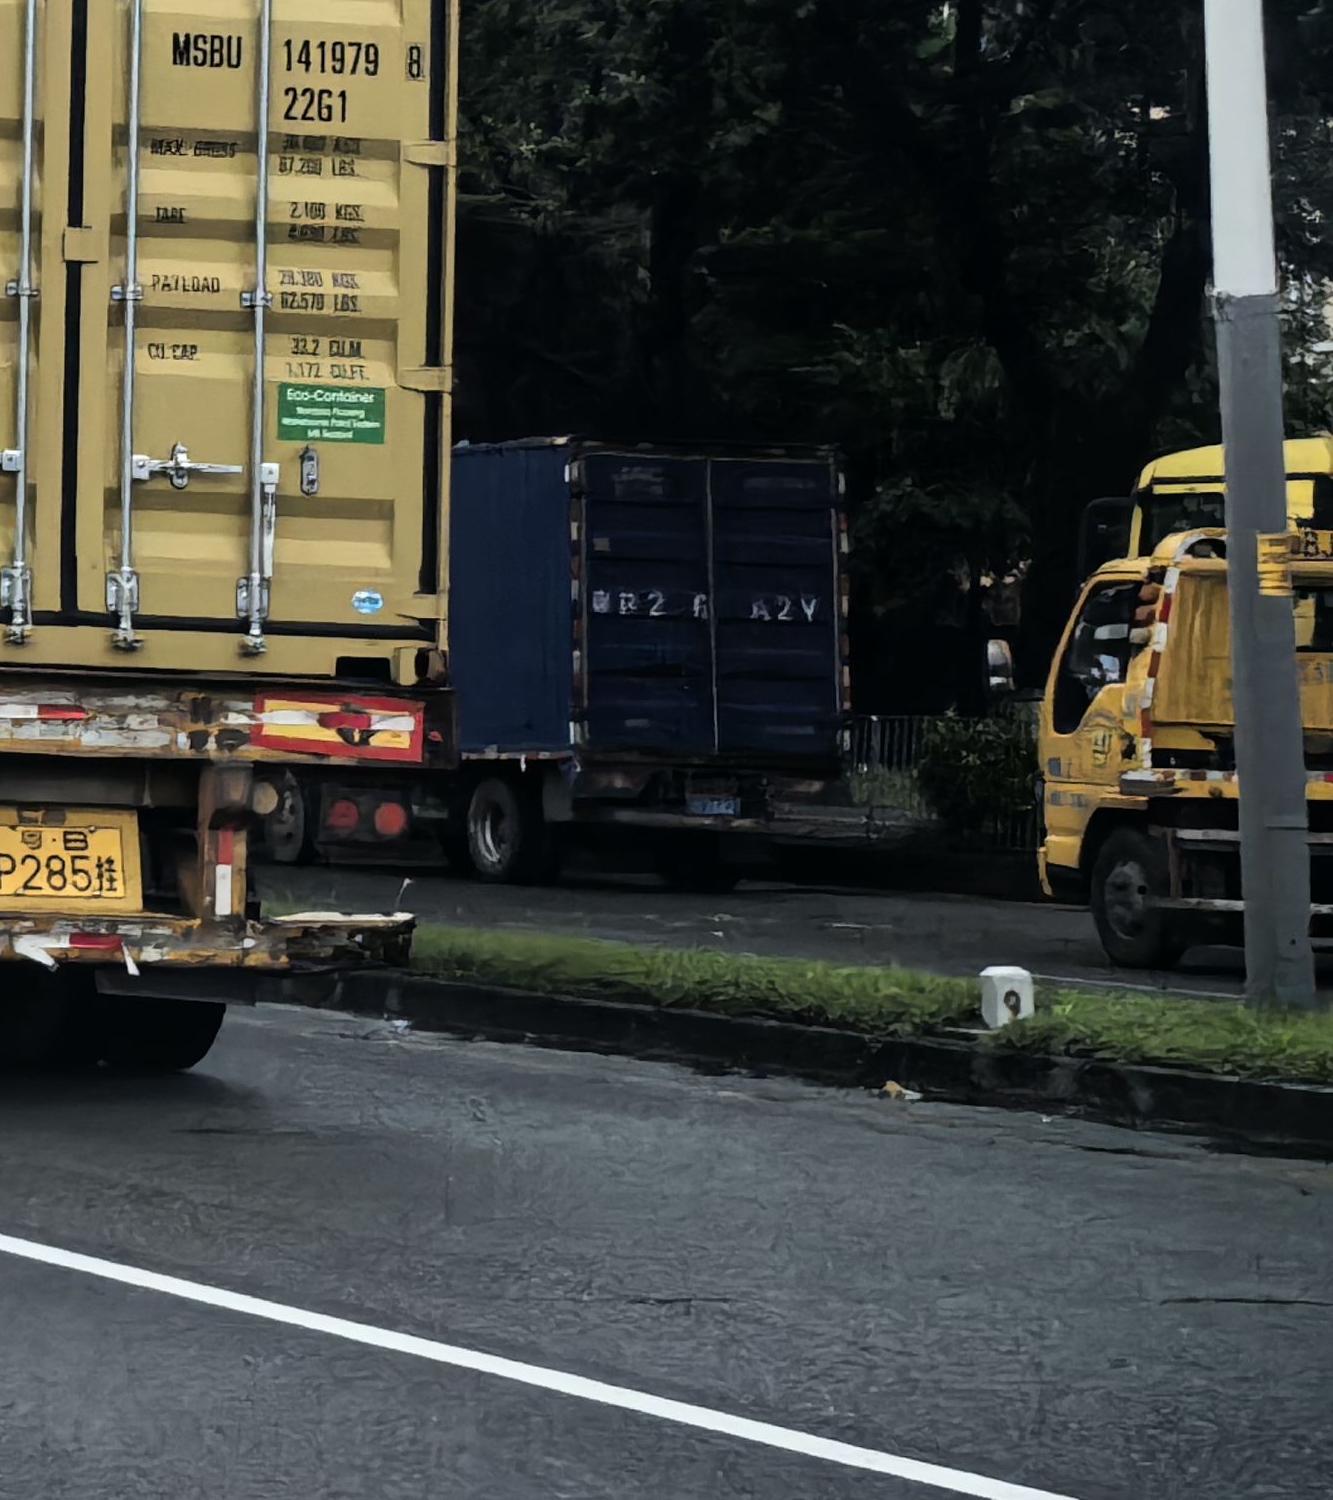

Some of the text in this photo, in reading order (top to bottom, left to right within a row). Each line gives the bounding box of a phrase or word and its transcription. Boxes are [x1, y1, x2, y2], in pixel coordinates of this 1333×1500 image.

[172, 32, 422, 79] MSBU 141979 8
[283, 86, 348, 123] 22G1
[151, 274, 221, 293] PAYLOAD
[287, 388, 375, 403] Eco-Container
